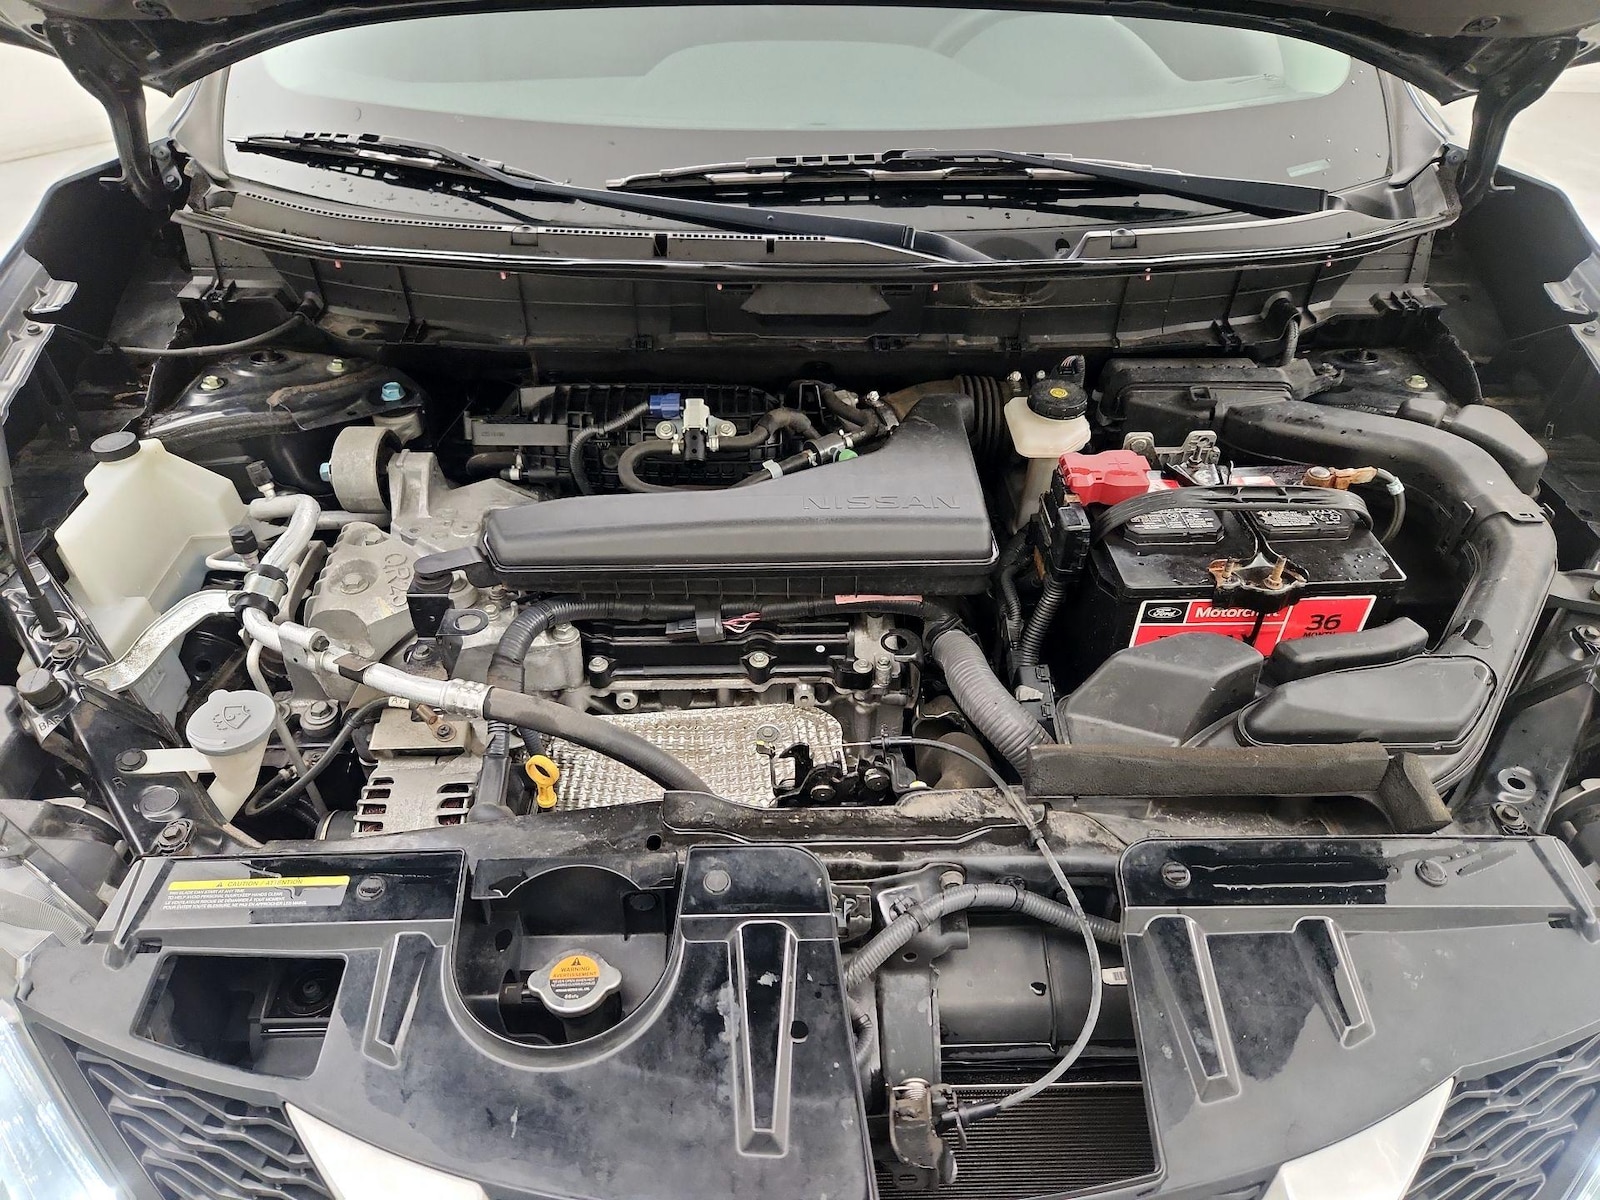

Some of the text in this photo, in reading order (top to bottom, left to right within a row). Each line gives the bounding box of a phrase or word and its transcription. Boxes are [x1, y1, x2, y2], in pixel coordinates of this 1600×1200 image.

[803, 496, 960, 509] NISSAN
[1305, 614, 1342, 631] 36
[112, 776, 127, 789] R
